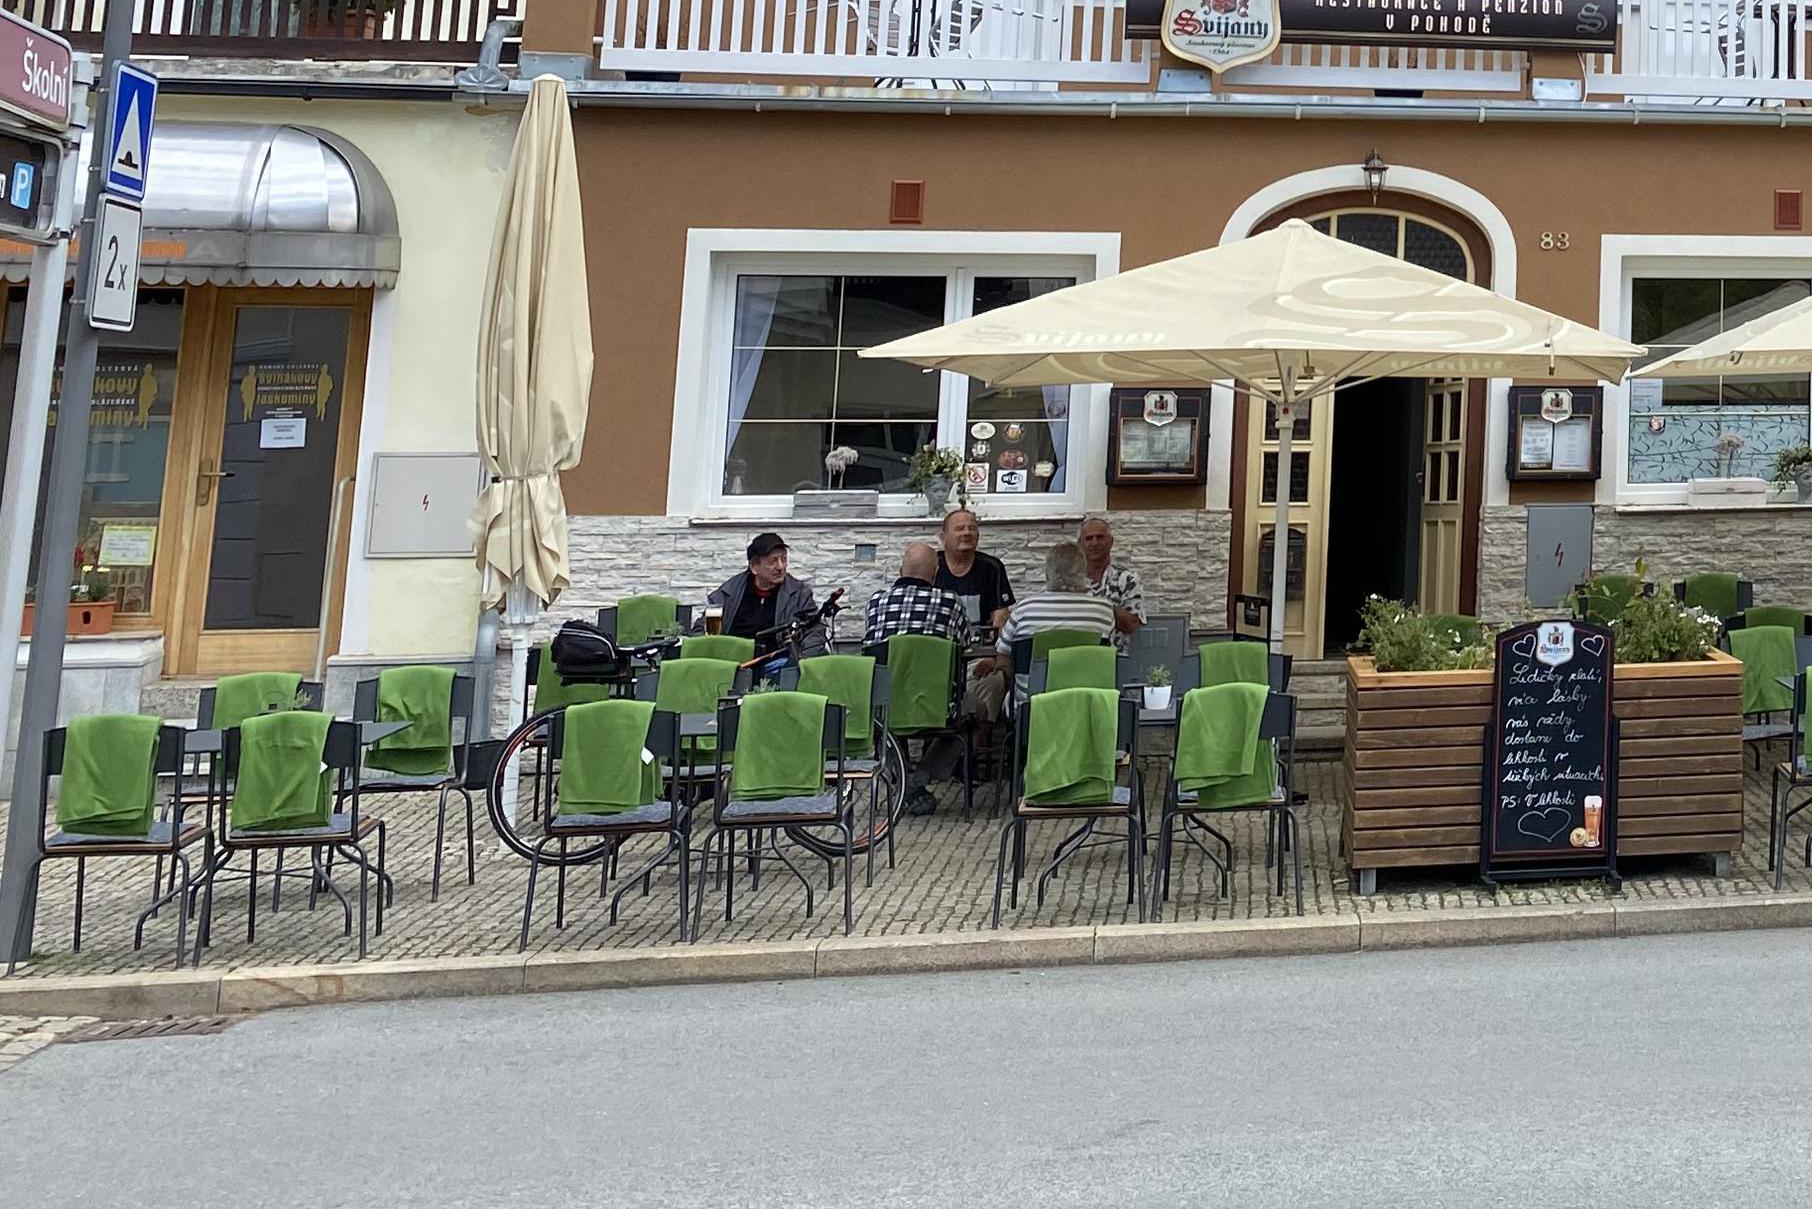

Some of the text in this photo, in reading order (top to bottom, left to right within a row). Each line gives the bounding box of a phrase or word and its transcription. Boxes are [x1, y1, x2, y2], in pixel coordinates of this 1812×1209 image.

[1172, 9, 1269, 40] Svijany
[1385, 13, 1492, 34] V POHODĚ
[22, 36, 68, 108] Školní
[14, 168, 29, 202] P
[1540, 231, 1570, 250] 83
[1564, 729, 1584, 743] do
